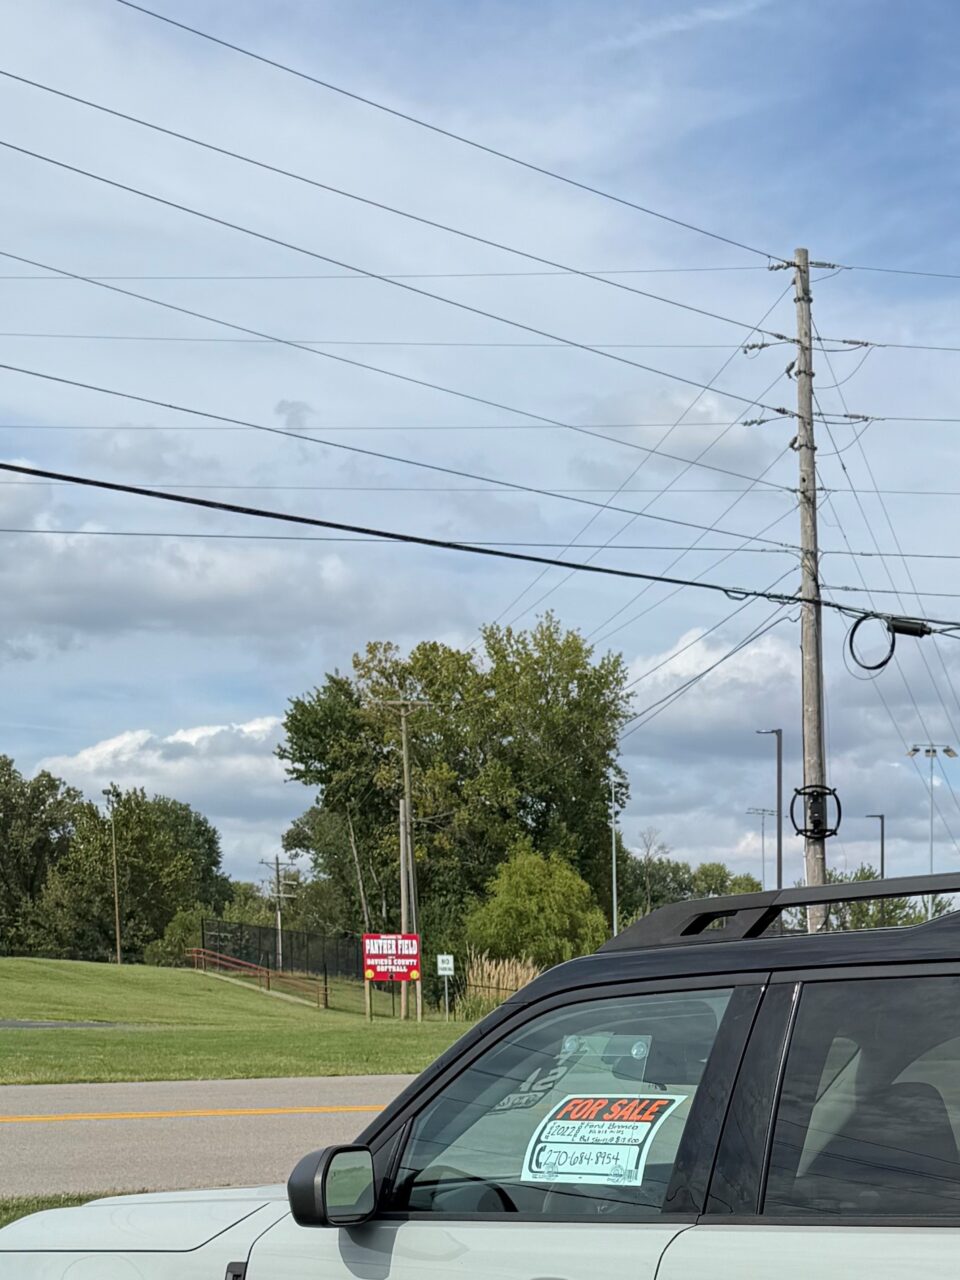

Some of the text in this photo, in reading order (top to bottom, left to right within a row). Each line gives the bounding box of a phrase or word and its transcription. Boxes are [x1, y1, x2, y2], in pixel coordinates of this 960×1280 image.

[365, 939, 418, 955] PANTHER FIELD
[556, 1099, 609, 1120] FOR
[603, 1099, 669, 1121] SALE
[551, 1125, 576, 1137] 2022
